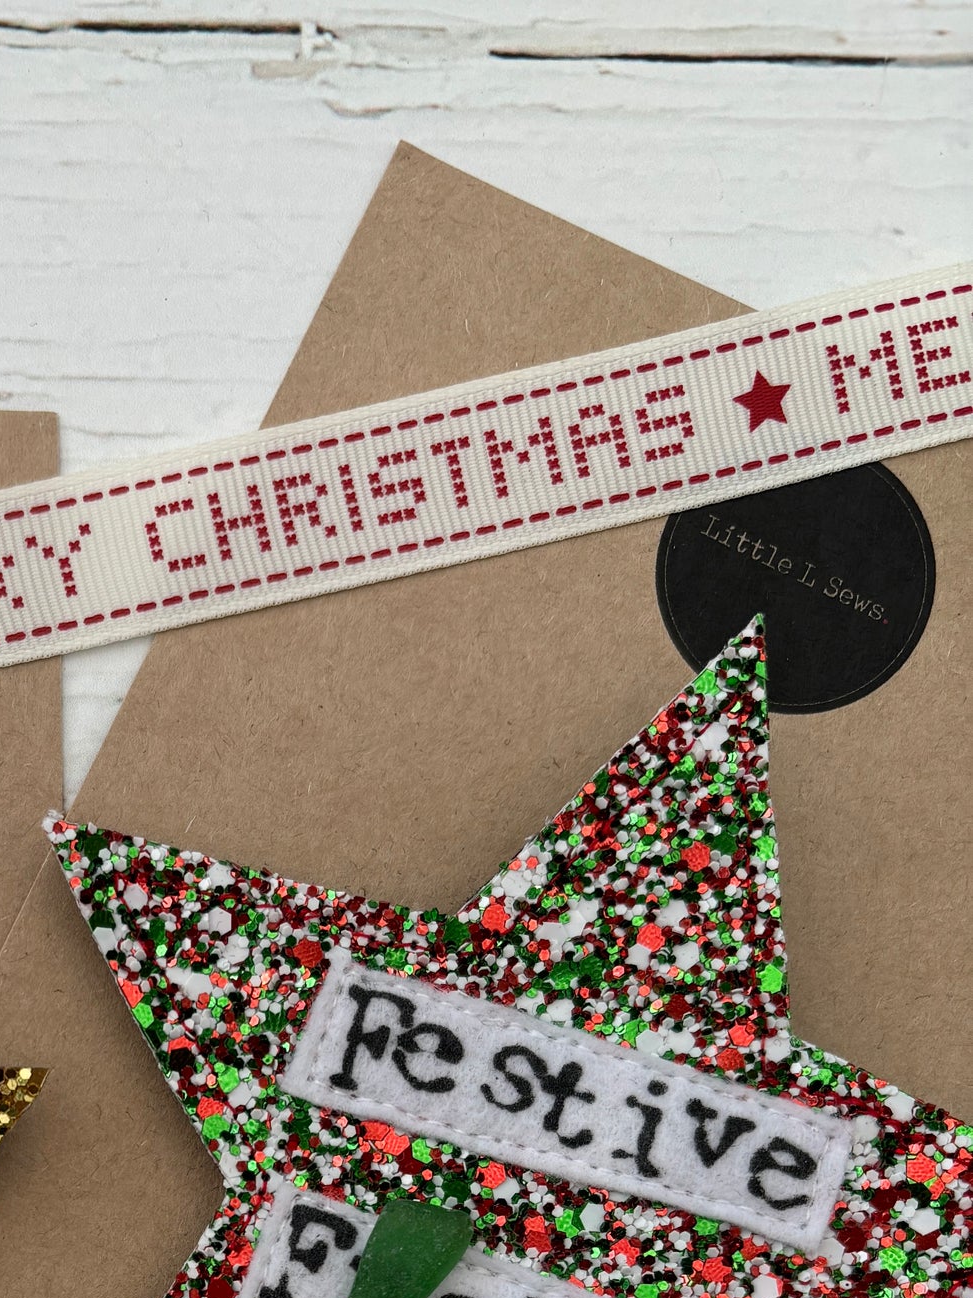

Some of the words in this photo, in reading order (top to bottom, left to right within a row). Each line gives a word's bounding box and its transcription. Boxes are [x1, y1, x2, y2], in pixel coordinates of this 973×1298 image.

[145, 384, 696, 573] CHRISTMAS
[826, 311, 973, 415] ME
[700, 514, 793, 575] Little
[796, 561, 817, 588] L
[329, 983, 818, 1211] Festive
